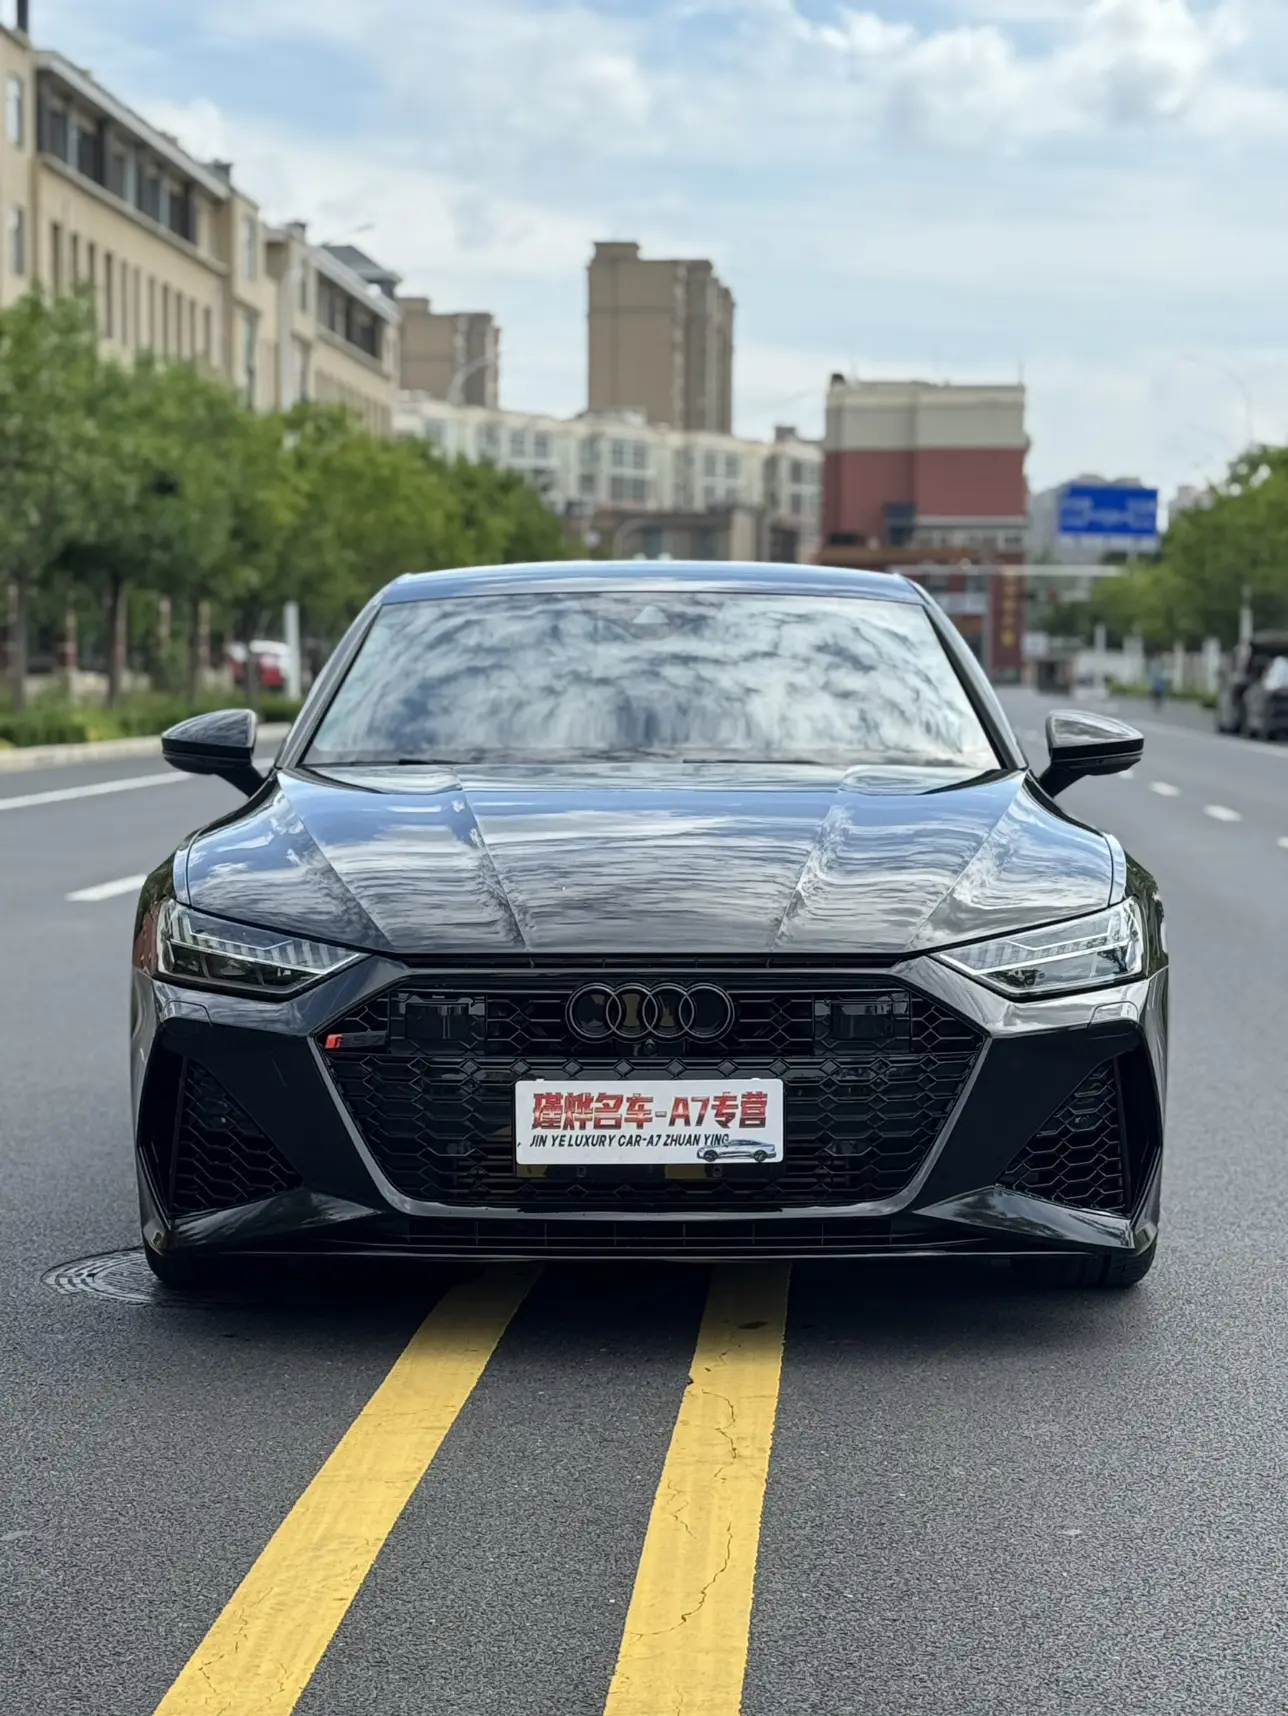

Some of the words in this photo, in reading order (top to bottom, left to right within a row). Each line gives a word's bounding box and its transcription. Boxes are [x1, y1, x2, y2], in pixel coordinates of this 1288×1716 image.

[530, 1134, 548, 1147] JIN
[617, 1134, 662, 1147] CAR-A7
[663, 1134, 701, 1147] ZHUAN
